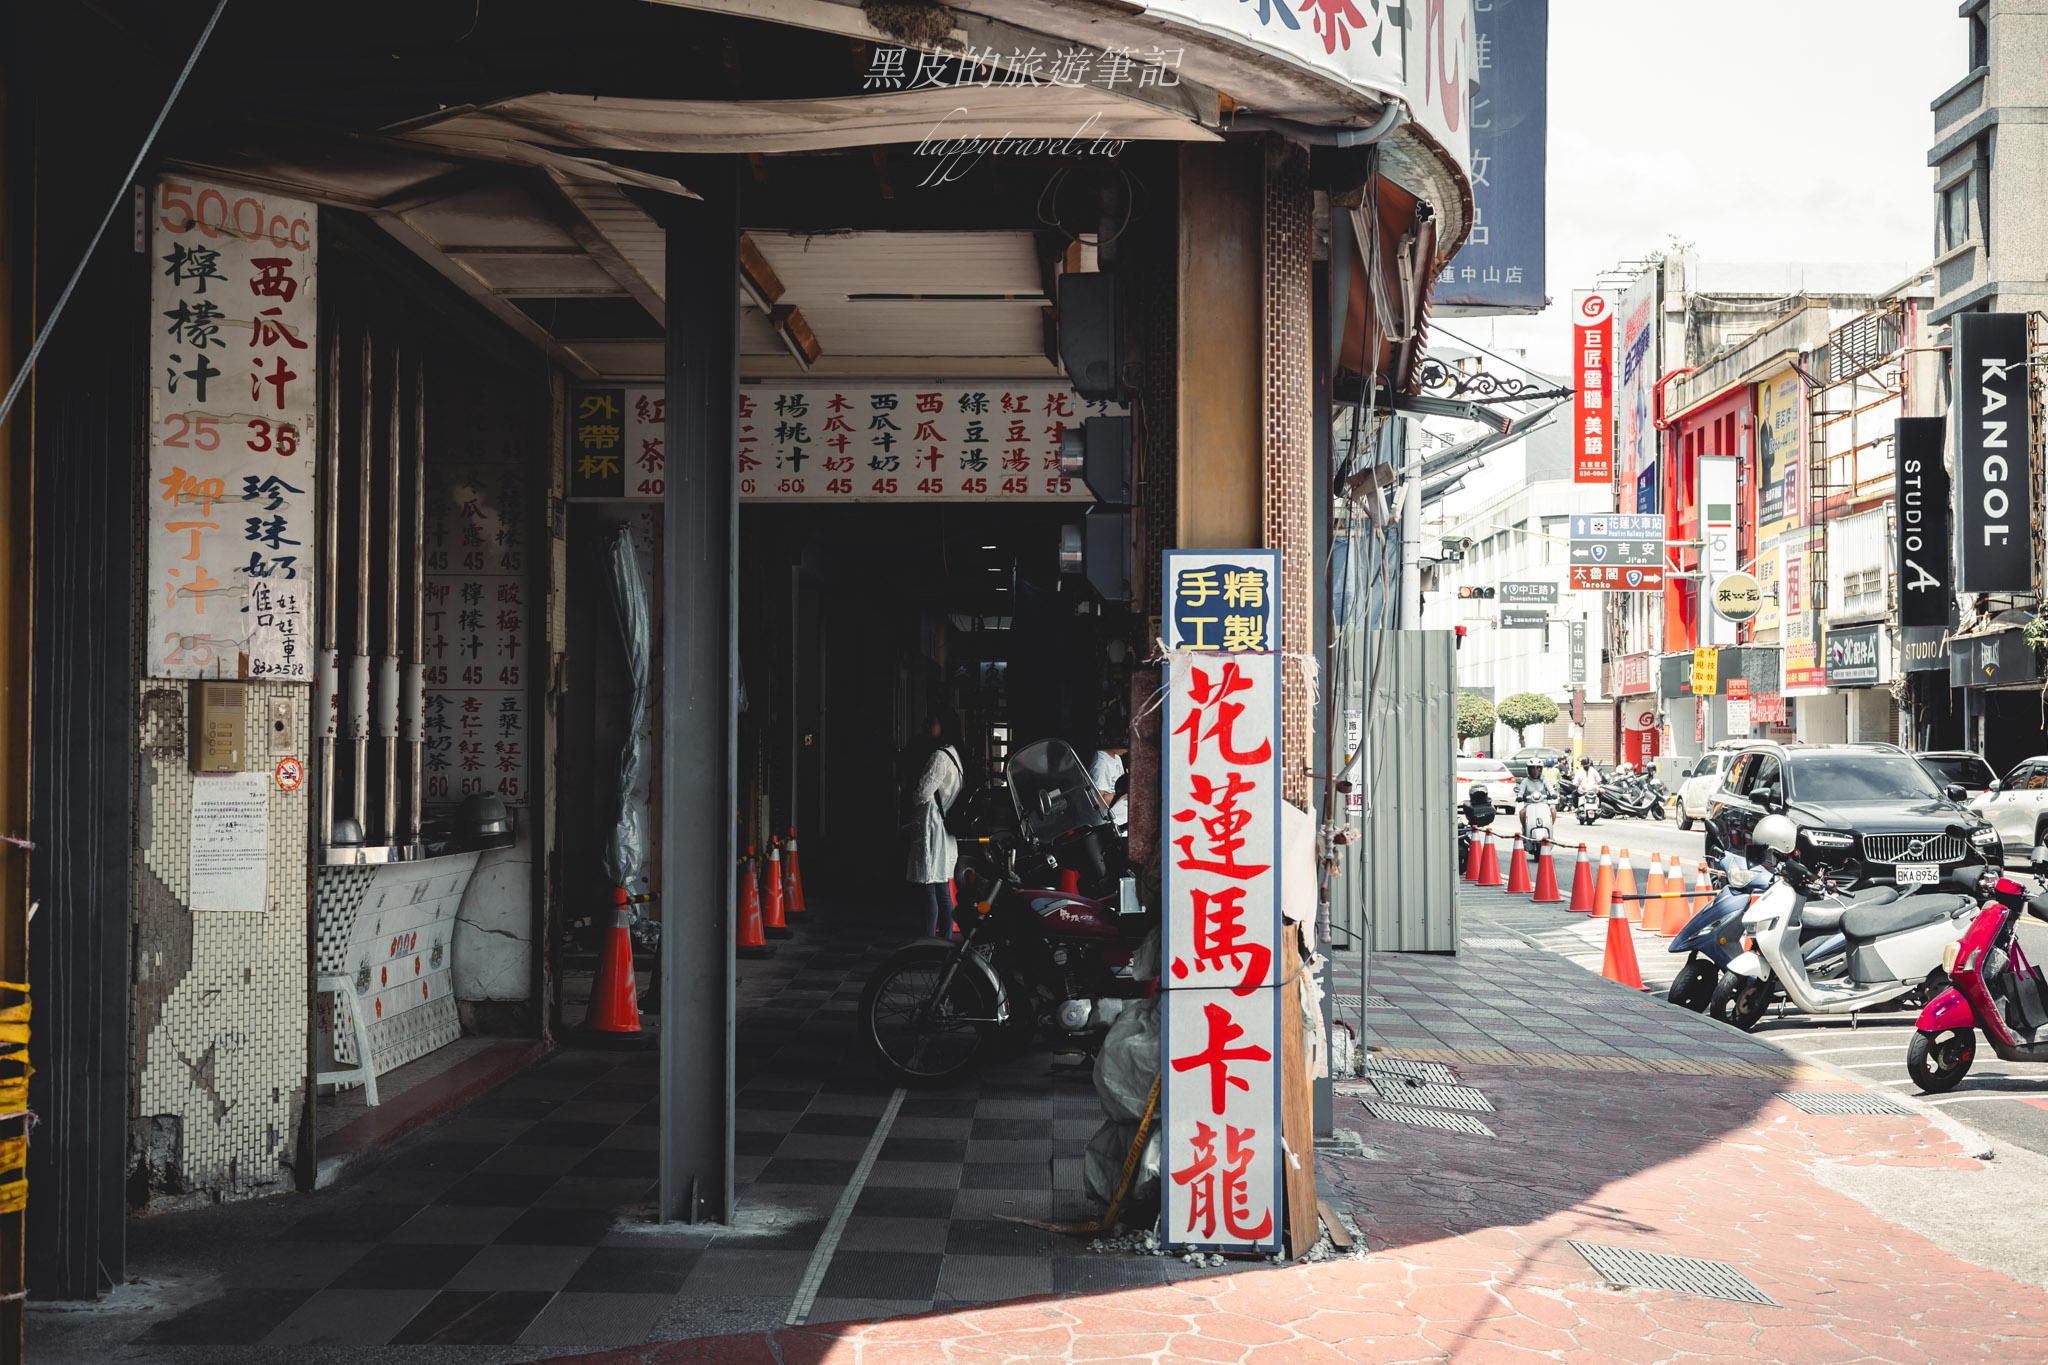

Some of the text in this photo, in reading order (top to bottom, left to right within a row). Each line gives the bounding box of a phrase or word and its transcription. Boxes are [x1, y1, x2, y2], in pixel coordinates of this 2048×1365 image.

[160, 183, 310, 252] 500cc
[162, 241, 229, 403] 檸檬汁
[249, 257, 308, 410] 西瓜汁
[162, 413, 221, 451] 25
[246, 419, 297, 457] 35
[578, 394, 620, 480] 外帶杯
[774, 394, 811, 473] 楊桃汁
[822, 393, 856, 473] 木瓜牛奶
[868, 393, 901, 472] 西瓜牛奶
[913, 393, 947, 472] 西瓜汁
[958, 392, 990, 472] 綠豆湯
[1000, 393, 1031, 472] 紅豆湯
[1981, 358, 2010, 546] KANGOL
[826, 478, 852, 494] 45
[872, 478, 898, 494] 45
[917, 478, 943, 494] 45
[961, 478, 987, 494] 45
[1002, 478, 1028, 494] 45
[159, 465, 225, 615] 柳丁汁
[1609, 517, 1662, 529] 花蓮火車站
[1904, 459, 1941, 593] STUDIO A
[241, 475, 305, 613] 珍珠奶
[428, 551, 448, 570] 45
[463, 551, 484, 570] 45
[1618, 542, 1655, 555] 吉安
[1519, 585, 1548, 595] 中正路
[1574, 567, 1618, 580] 太魯閣
[1581, 581, 1610, 589] Taroko
[275, 594, 301, 664] 娃娃車
[458, 582, 486, 660] 檸檬汁
[496, 582, 524, 660] 酸梅汁
[1179, 570, 1220, 651] 手工
[1222, 570, 1264, 651] 精製
[163, 632, 213, 666] 25
[252, 658, 304, 676] 8323588
[1573, 630, 1583, 668] 中山路
[1905, 640, 1937, 661] STUDIO
[427, 666, 448, 685] 45
[463, 666, 483, 685] 45
[499, 666, 519, 685] 45
[425, 695, 454, 771] 珍珠奶茶
[428, 776, 449, 797] 60
[498, 776, 519, 797] 45
[1171, 662, 1272, 1240] 花蓮馬卡龍
